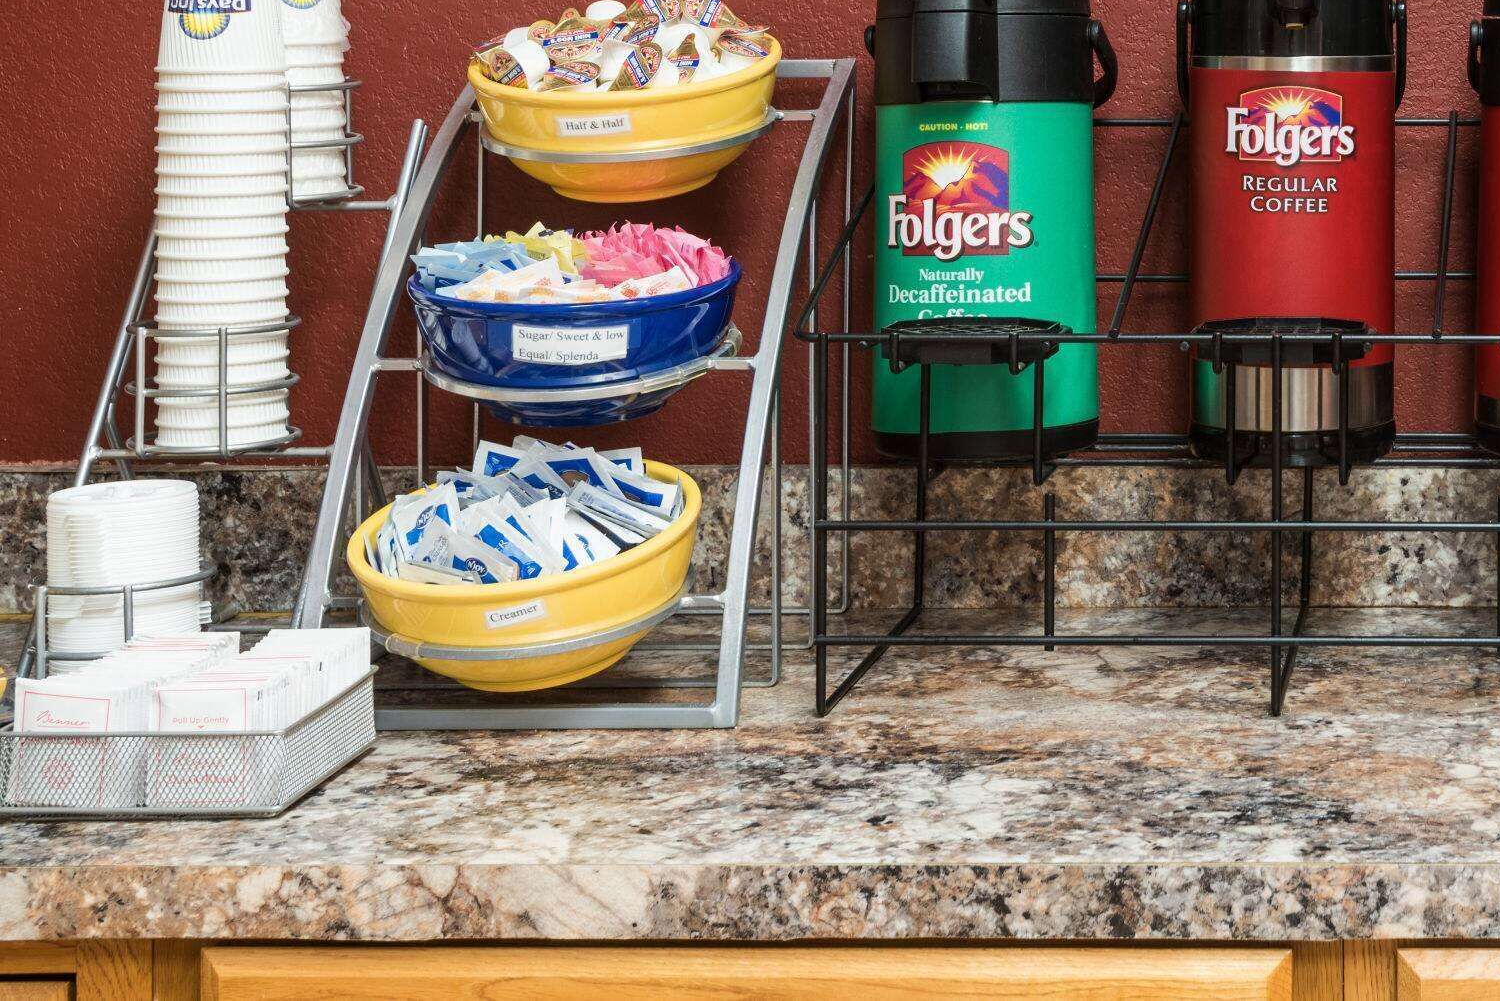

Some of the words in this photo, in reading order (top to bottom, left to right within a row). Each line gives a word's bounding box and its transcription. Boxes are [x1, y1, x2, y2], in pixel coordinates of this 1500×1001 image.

[566, 120, 587, 130] Half
[590, 120, 599, 130] &
[602, 118, 624, 128] Half
[919, 123, 958, 132] CAUTION
[965, 123, 989, 131] HOT!
[1225, 106, 1355, 167] Folgers
[1242, 175, 1338, 192] REGULAR
[1250, 196, 1328, 213] COFFEE
[887, 193, 1033, 262] Folgers
[919, 268, 985, 284] Naturally
[888, 282, 1032, 304] Decaffeinated
[518, 329, 554, 342] Sugar/
[556, 331, 588, 342] Sweet
[592, 331, 601, 341] &
[519, 348, 552, 360] Equal/
[556, 350, 599, 363] Splenda
[489, 604, 538, 623] Creamer
[190, 717, 200, 725] Up
[203, 716, 230, 726] Gently
